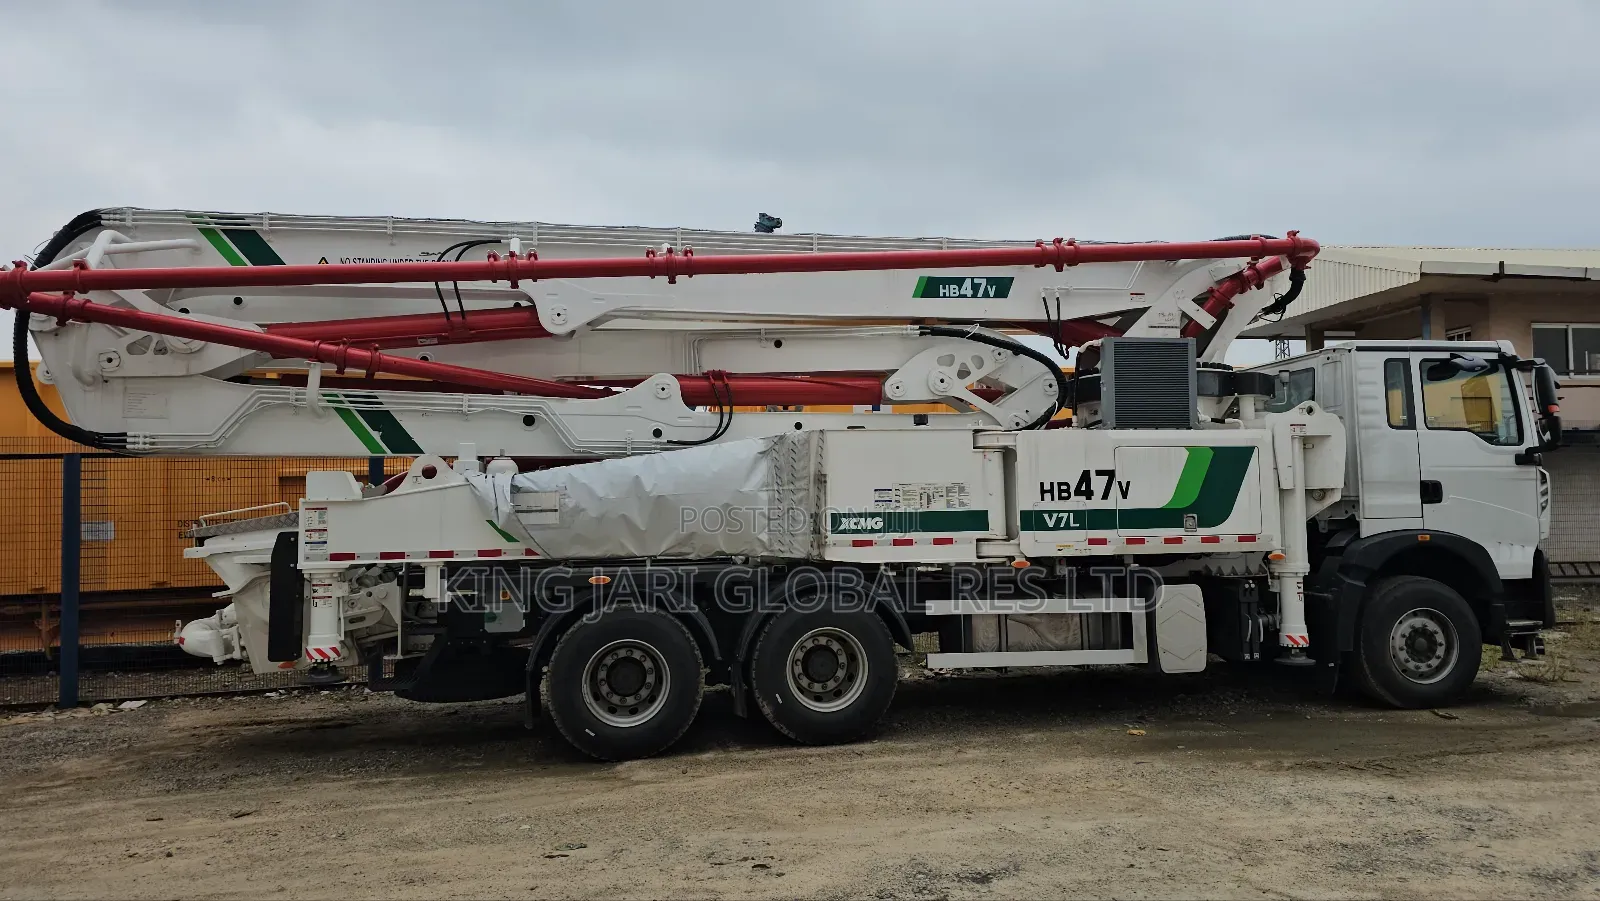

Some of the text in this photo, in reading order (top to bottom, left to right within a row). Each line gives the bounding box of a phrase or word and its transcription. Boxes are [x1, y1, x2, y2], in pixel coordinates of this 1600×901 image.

[939, 278, 997, 298] HB47V
[1039, 469, 1131, 501] HB47V
[839, 516, 884, 530] XCMG
[1042, 512, 1080, 528] V7L
